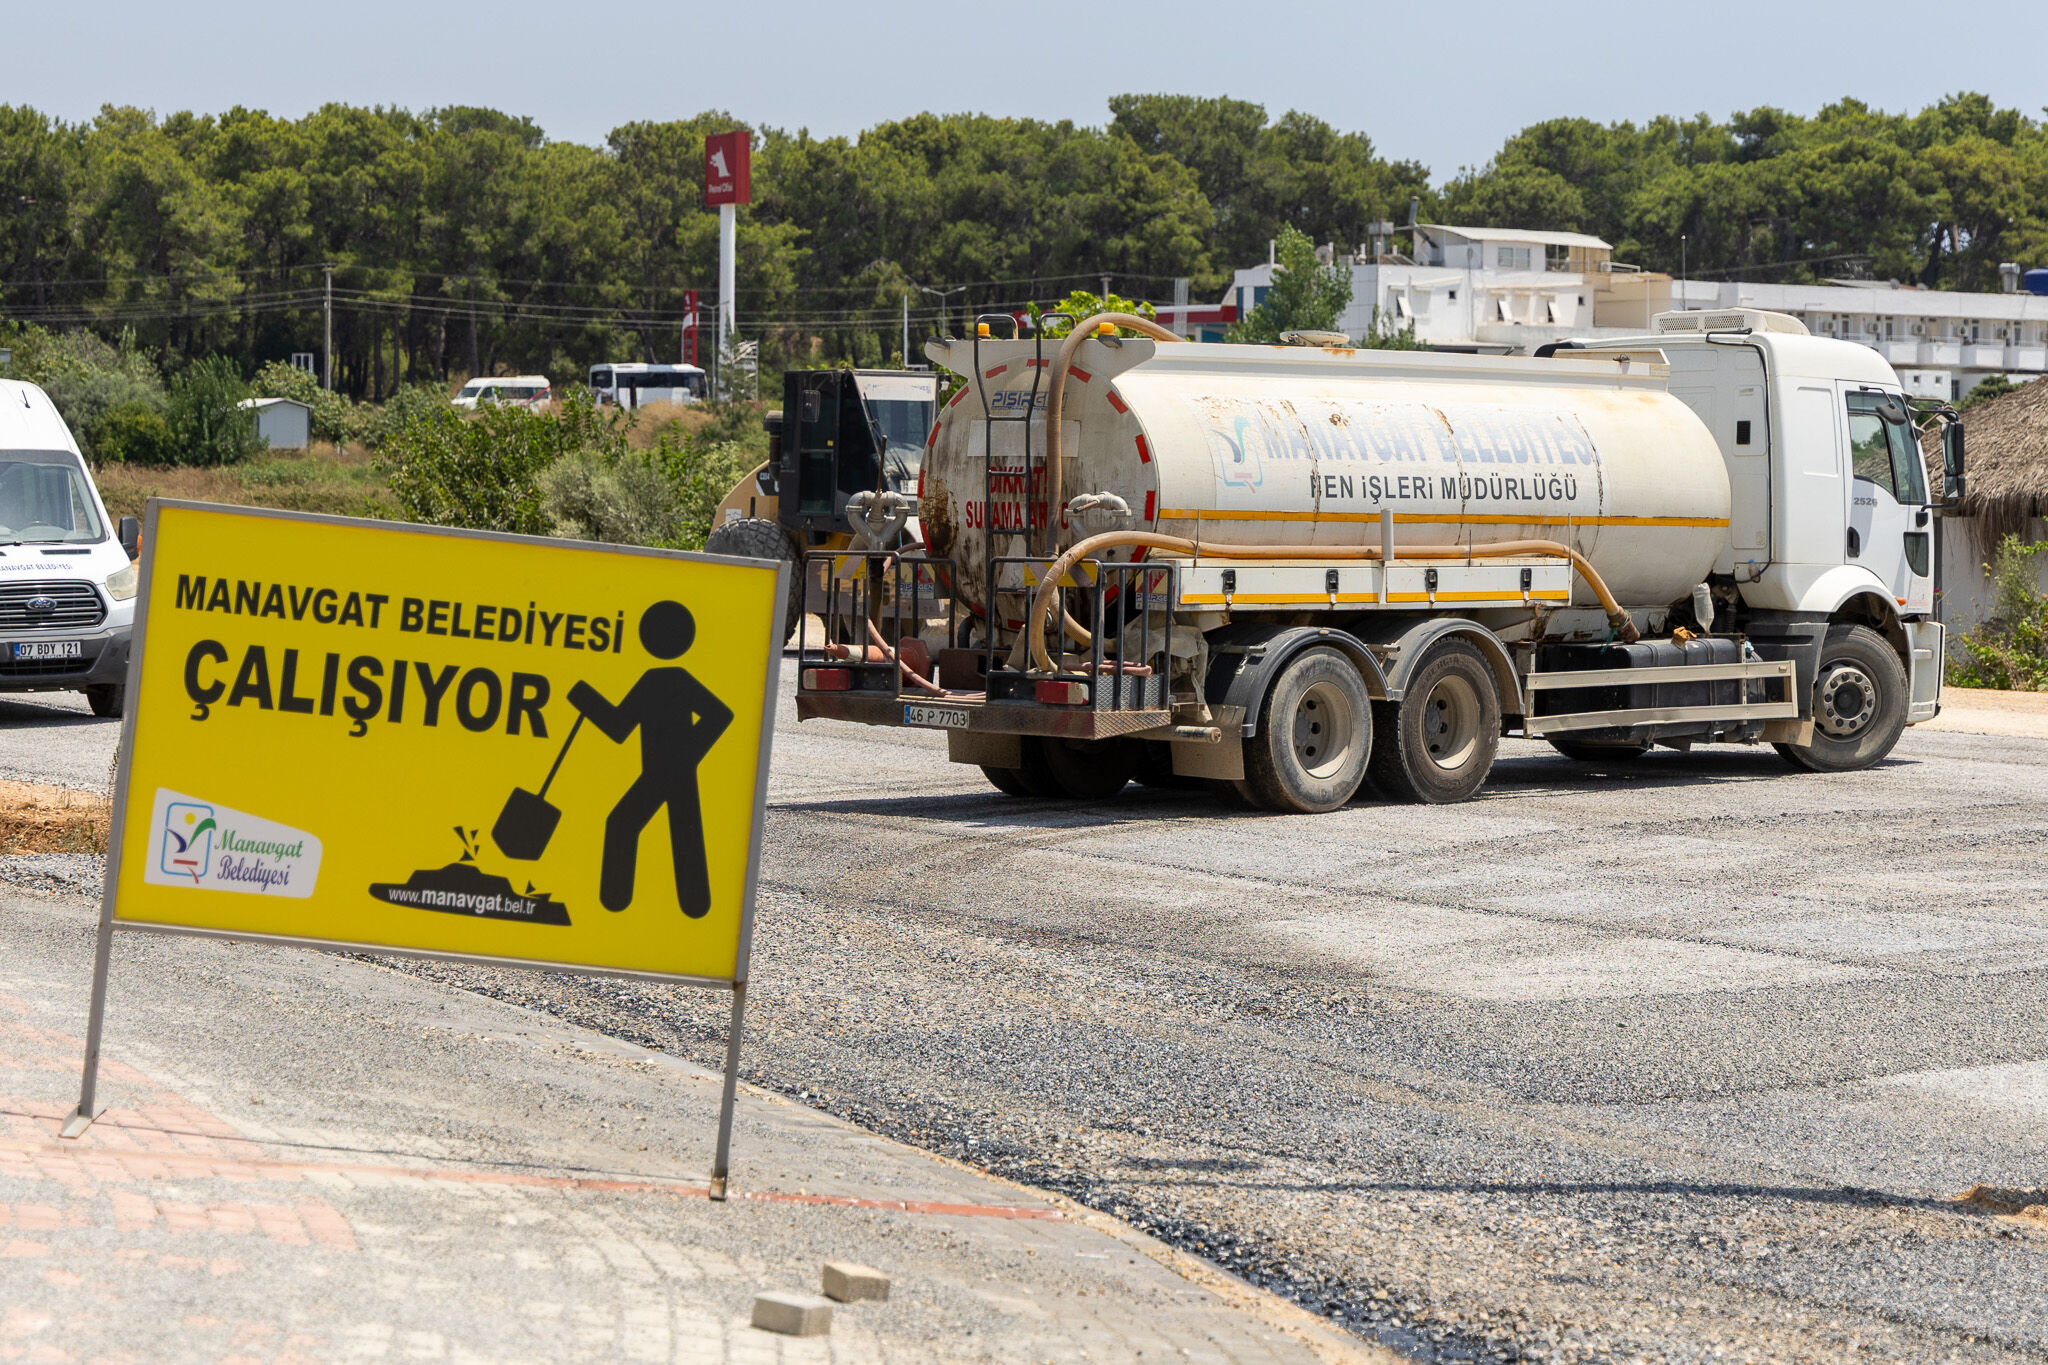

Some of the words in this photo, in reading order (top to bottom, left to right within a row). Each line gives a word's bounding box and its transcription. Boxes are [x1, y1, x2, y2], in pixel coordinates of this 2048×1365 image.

[1441, 472, 1577, 501] MÜDÜRLÜĞÜ
[1853, 497, 1878, 507] 2526
[175, 574, 389, 629] MANAVGAT
[400, 597, 624, 654] BELEDİYESİ
[20, 645, 33, 656] 07
[37, 643, 56, 655] BDY
[61, 642, 78, 654] 121
[184, 639, 551, 738] ÇALIŞIYOR
[910, 709, 924, 722] 46
[927, 711, 935, 723] P
[939, 711, 966, 727] 7703
[214, 829, 303, 863] Manavgat
[217, 855, 290, 892] Belediyesi
[388, 888, 536, 915] www.manavgat.bel.tr
